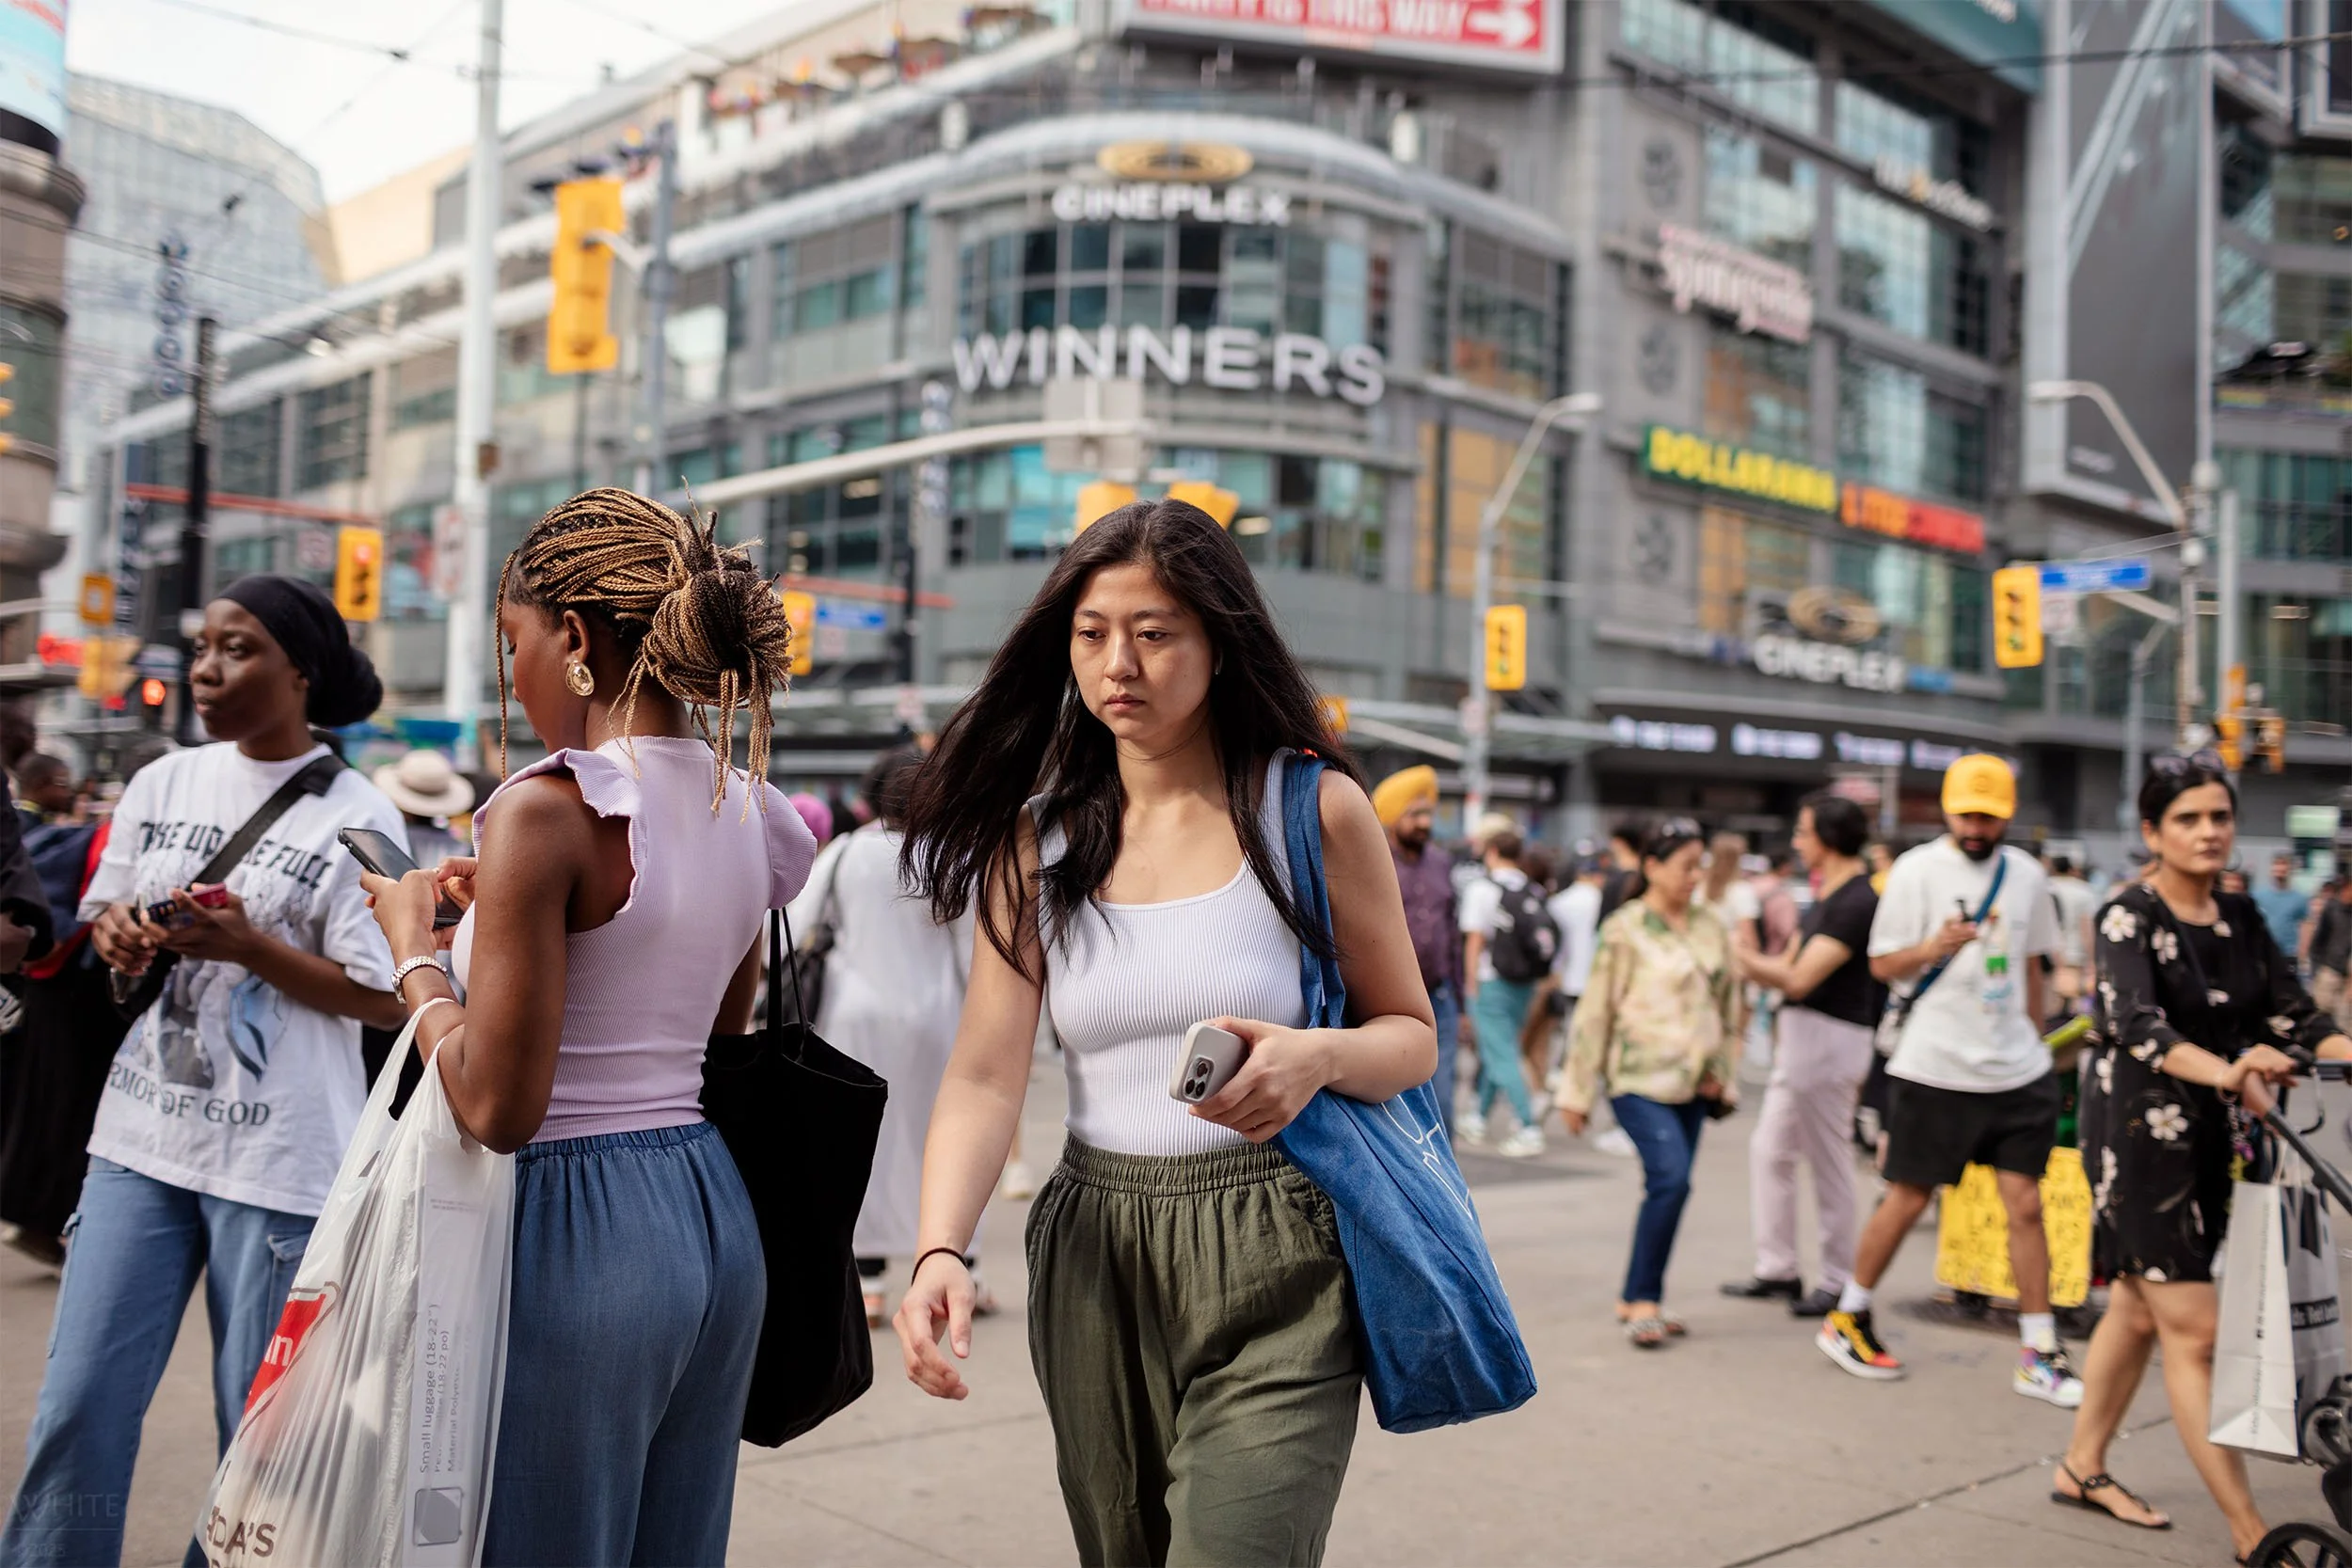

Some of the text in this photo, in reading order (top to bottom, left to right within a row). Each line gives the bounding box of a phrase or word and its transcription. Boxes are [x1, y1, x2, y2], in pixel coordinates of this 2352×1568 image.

[1052, 184, 1290, 226] CINEPLEX
[952, 323, 1386, 406] WINNERS
[160, 1091, 197, 1118] OF
[204, 1098, 270, 1126] GOD
[422, 1370, 435, 1428] luggage
[420, 1433, 432, 1473] Small
[448, 1419, 458, 1472] Material
